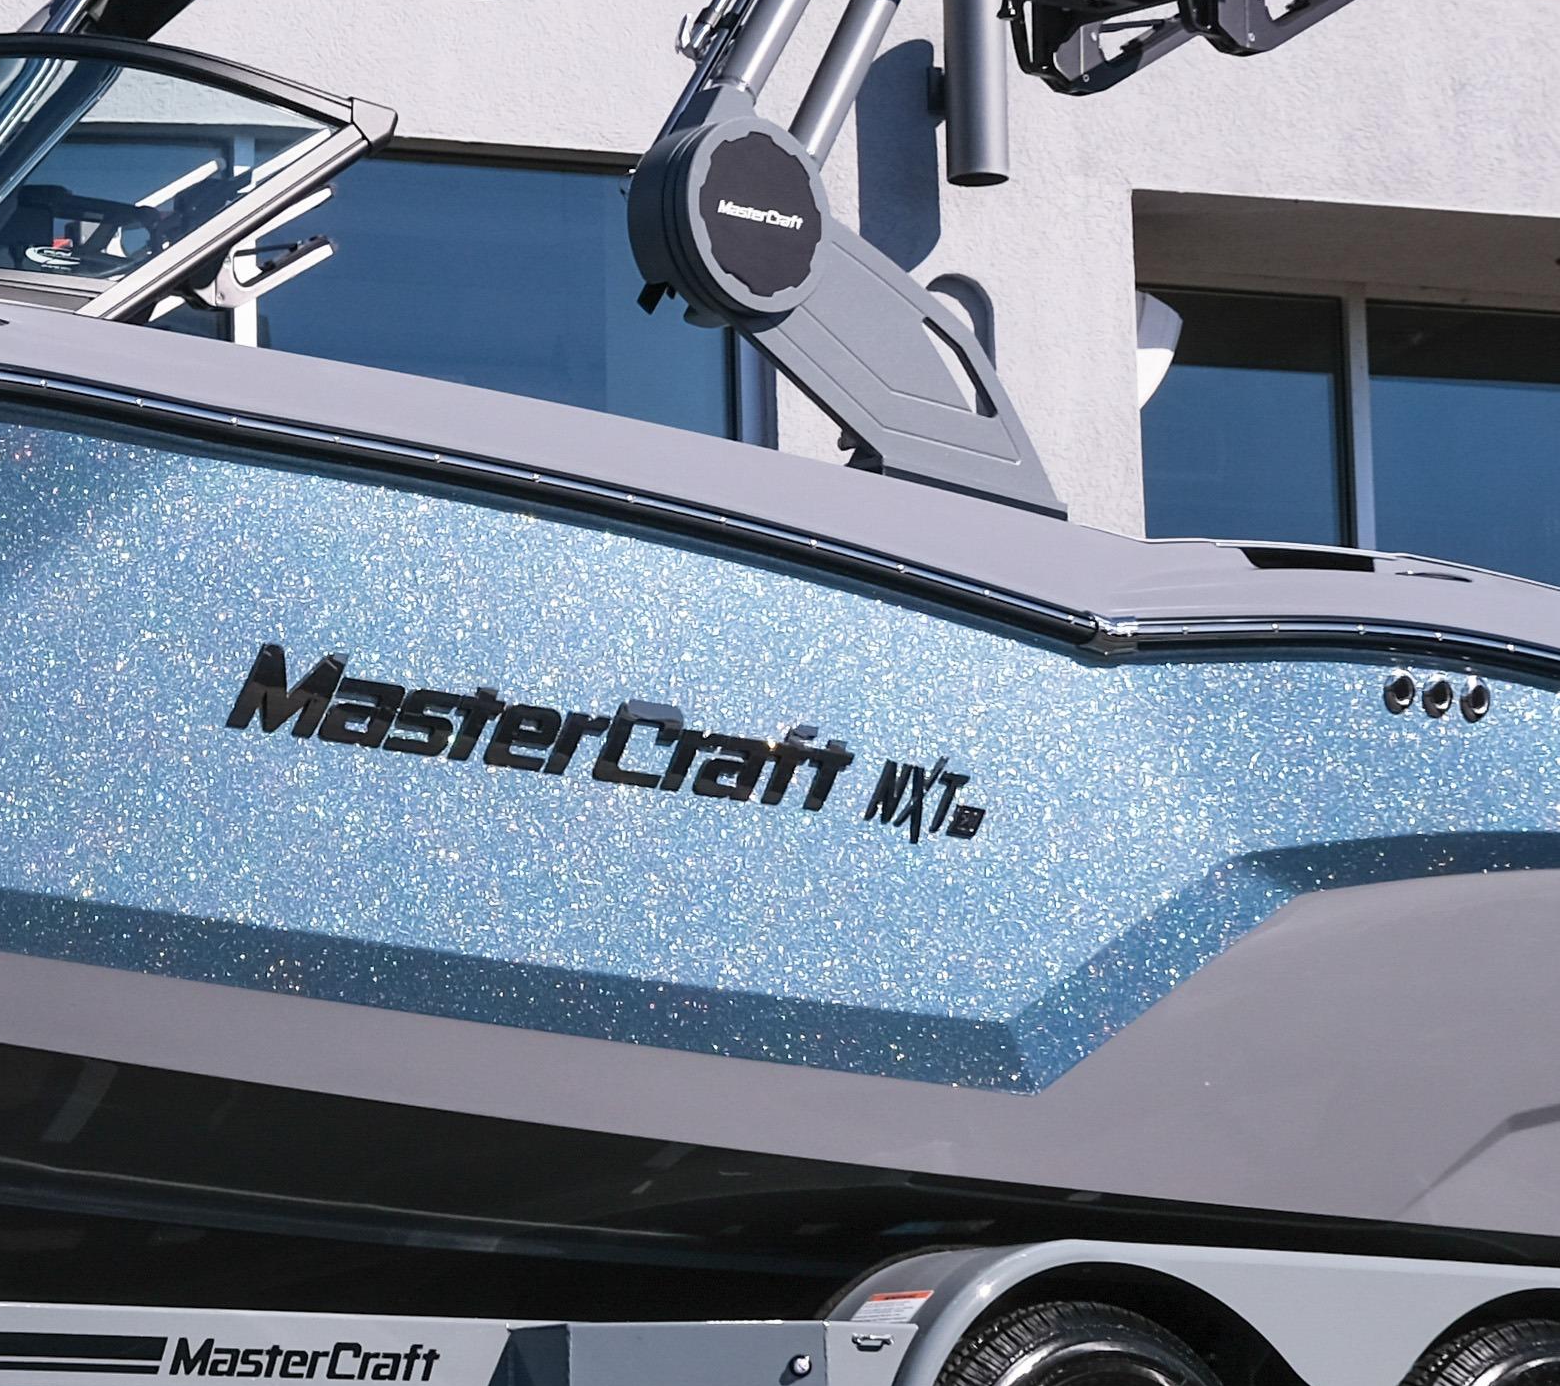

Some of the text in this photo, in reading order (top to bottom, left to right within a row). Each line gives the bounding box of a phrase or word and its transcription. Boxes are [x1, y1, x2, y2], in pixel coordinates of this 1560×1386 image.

[717, 199, 804, 230] MasterCraft
[226, 643, 854, 812] MasterCraft
[169, 1337, 440, 1382] MasterCraft
